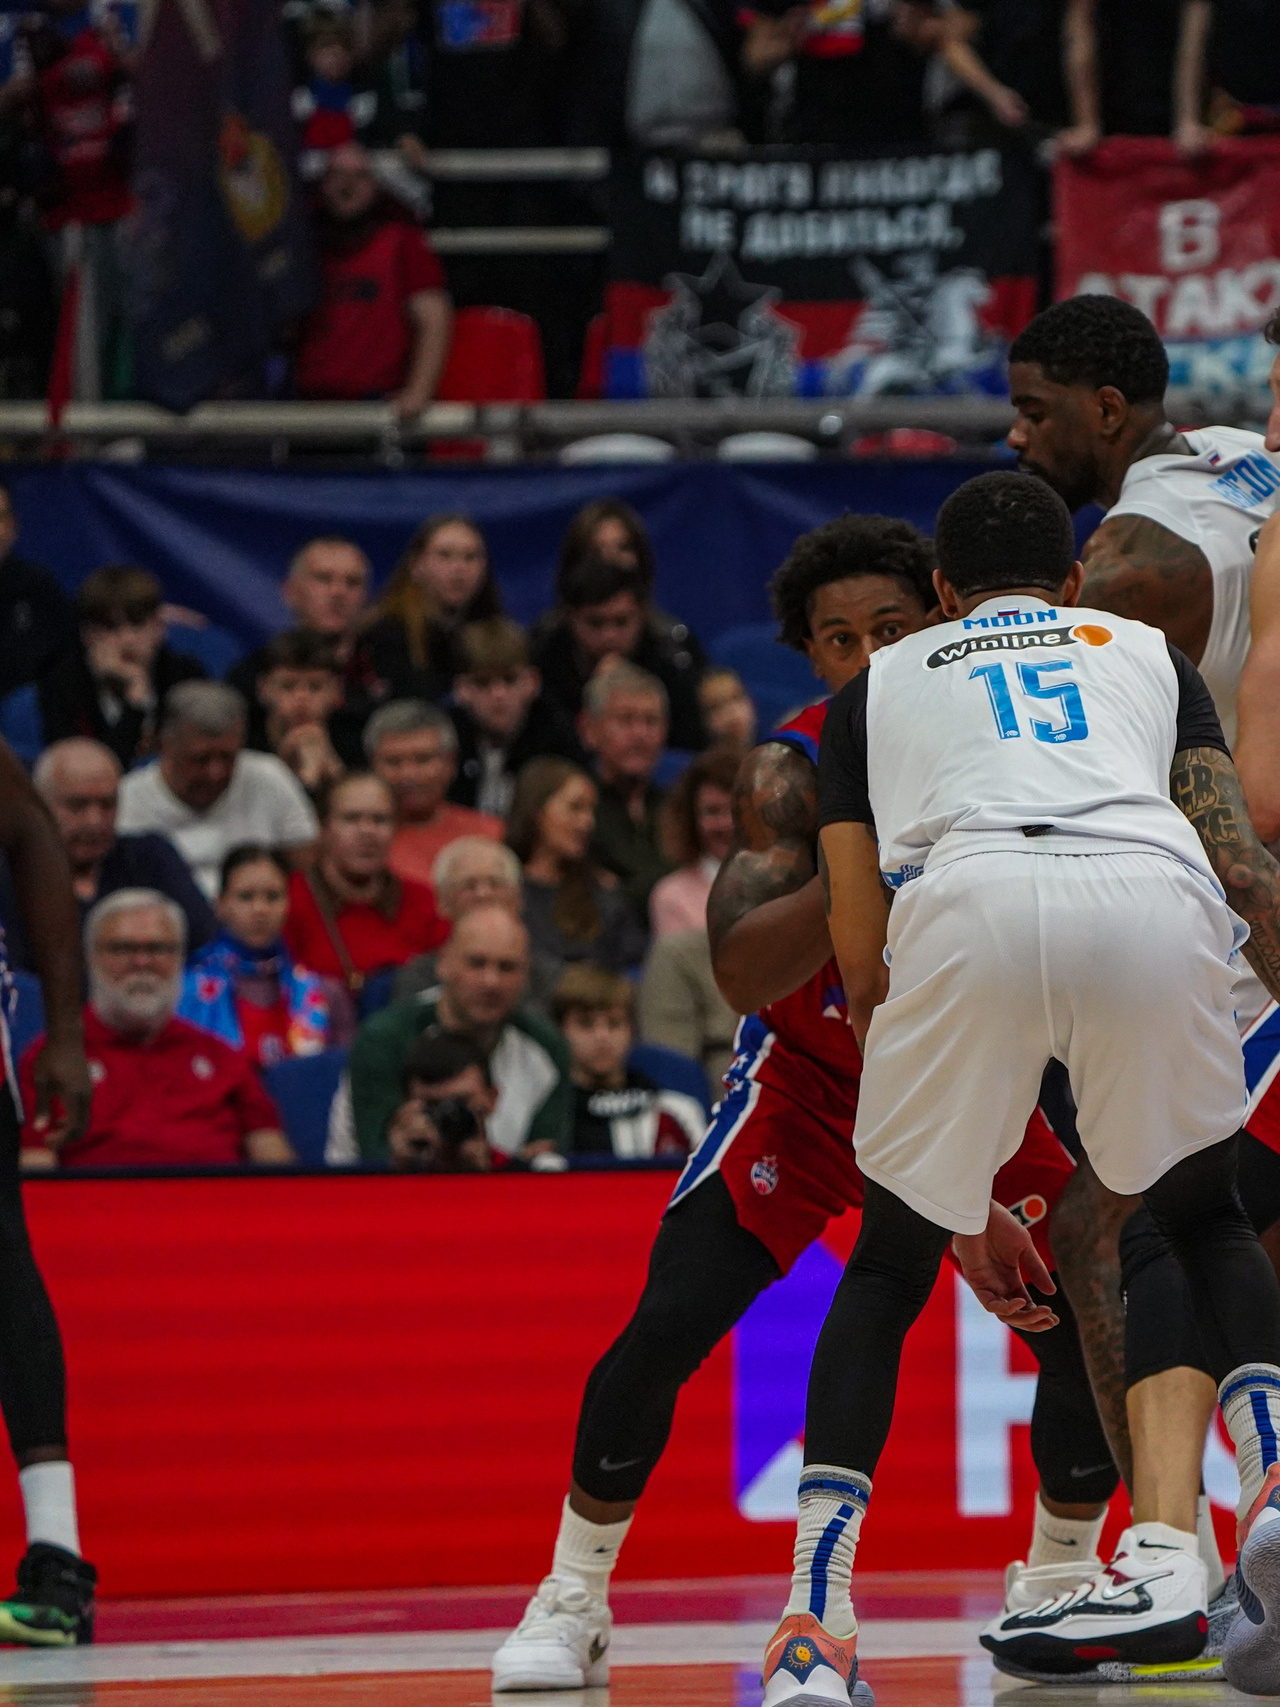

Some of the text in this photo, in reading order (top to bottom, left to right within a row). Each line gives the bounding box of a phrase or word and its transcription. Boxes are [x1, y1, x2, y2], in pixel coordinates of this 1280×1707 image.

[963, 609, 1058, 629] MOON
[938, 632, 1061, 662] Winline
[968, 660, 1089, 743] 15
